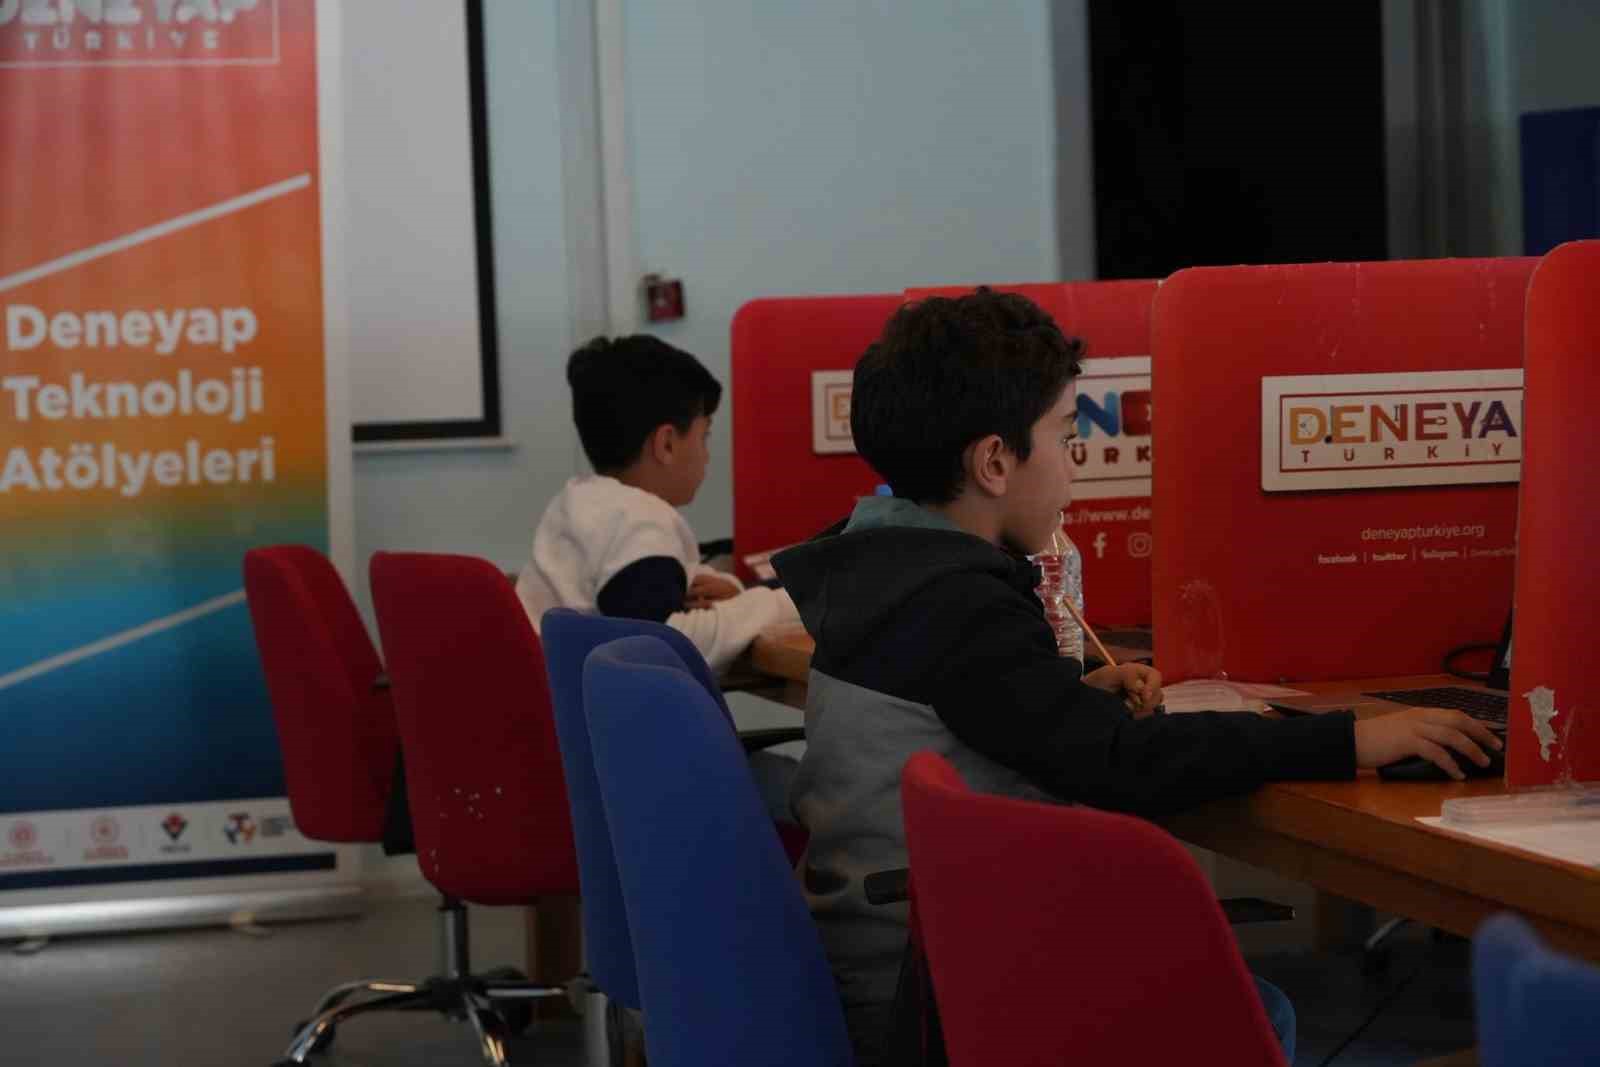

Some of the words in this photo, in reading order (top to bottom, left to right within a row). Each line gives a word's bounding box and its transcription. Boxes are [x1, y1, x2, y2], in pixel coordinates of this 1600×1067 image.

[6, 304, 258, 354] Deneyap
[1, 366, 265, 423] Teknoloji
[0, 436, 276, 497] Atölyeleri
[1360, 523, 1486, 542] deneyapturkiye.org
